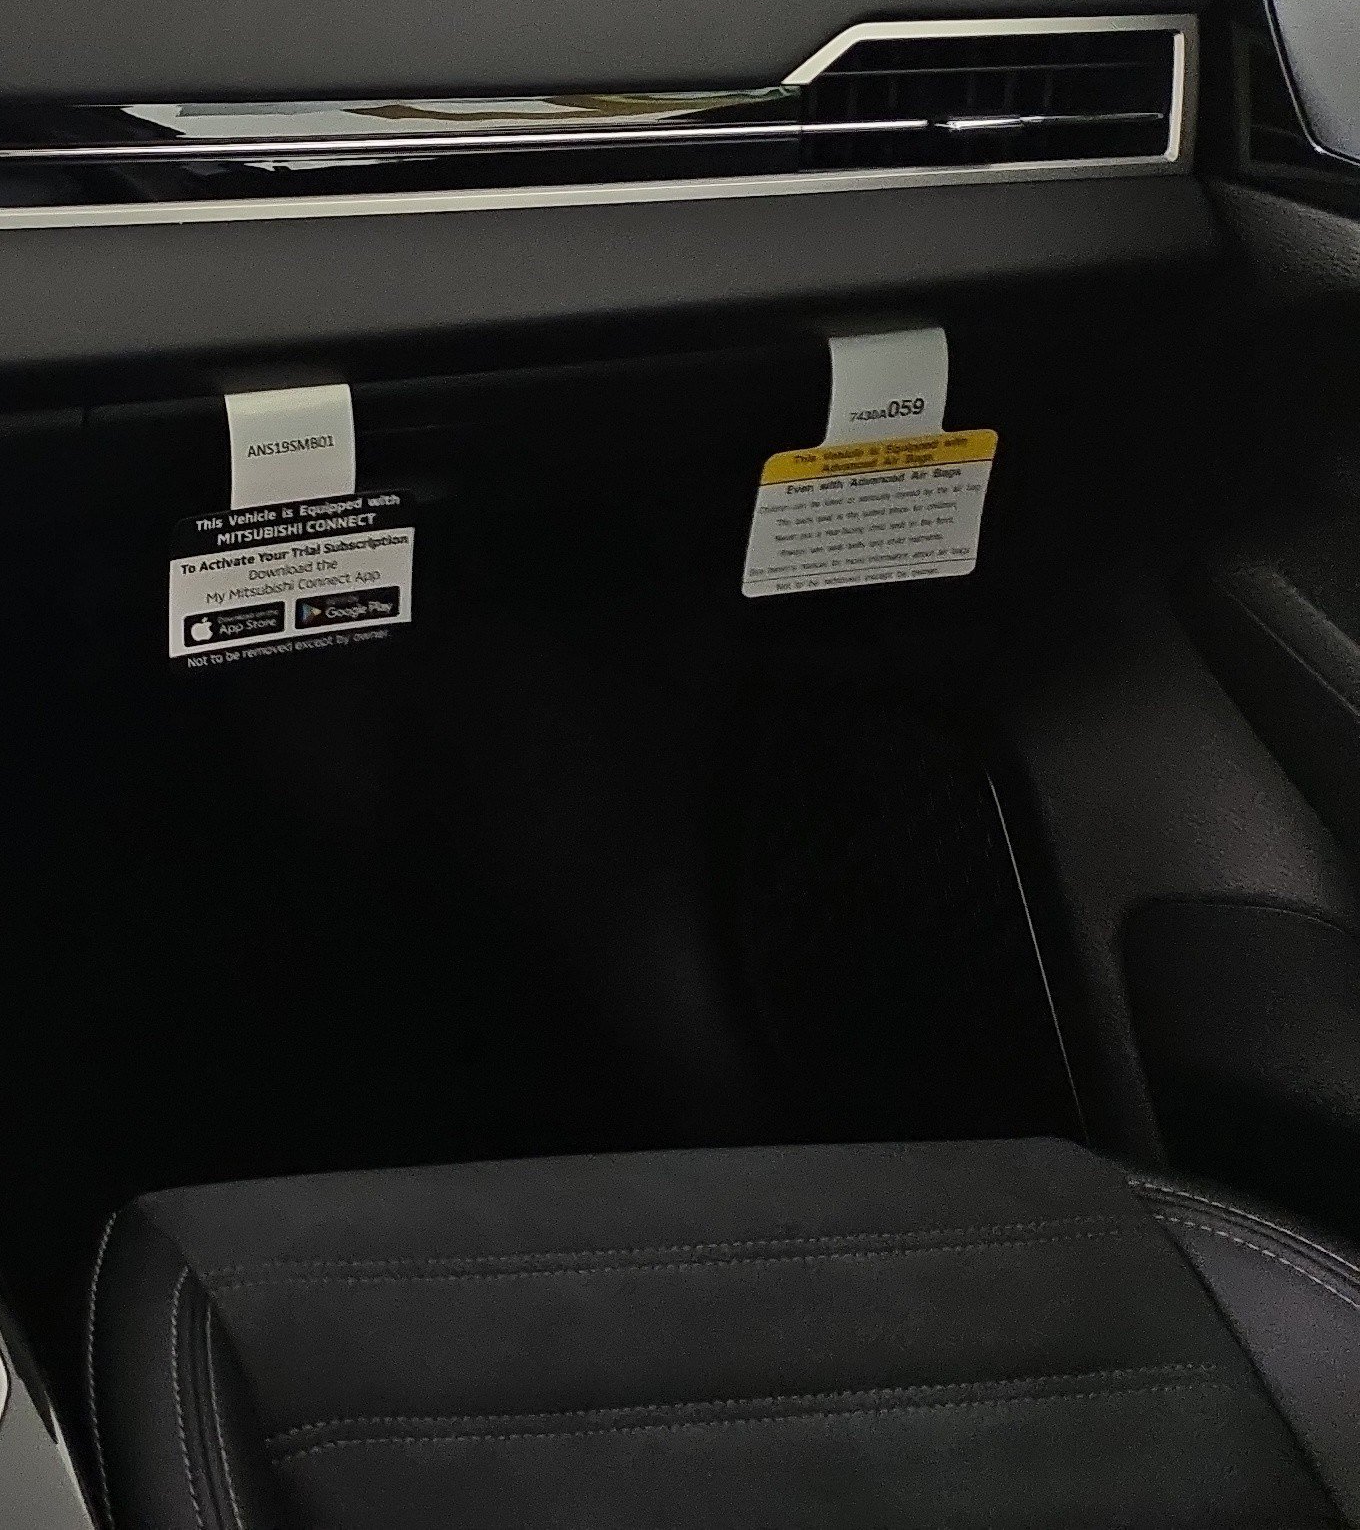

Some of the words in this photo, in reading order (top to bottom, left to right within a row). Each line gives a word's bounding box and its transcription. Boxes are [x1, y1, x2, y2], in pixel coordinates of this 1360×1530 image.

[786, 483, 814, 495] Even
[196, 517, 223, 532] This
[229, 510, 277, 526] Vehicle
[282, 507, 294, 519] is
[299, 498, 362, 517] Equipped
[367, 495, 401, 508] with
[217, 522, 303, 547] MITSUBISHI
[306, 512, 377, 533] CONNECT
[181, 563, 196, 575] To
[199, 555, 255, 575] Activate
[258, 551, 288, 563] Your
[292, 543, 321, 559] Trial
[324, 534, 410, 555] Subscription
[248, 561, 313, 581] Download
[316, 558, 338, 571] the
[206, 591, 225, 606] My
[229, 579, 295, 600] Mitsubishi
[297, 572, 352, 591] Connect
[355, 570, 381, 586] App
[325, 603, 366, 621] Google
[368, 601, 394, 616] Play
[218, 622, 243, 637] App
[246, 617, 277, 630] Store
[187, 656, 208, 668] Not
[211, 654, 224, 665] to
[226, 649, 241, 662] be
[242, 640, 294, 658] removed
